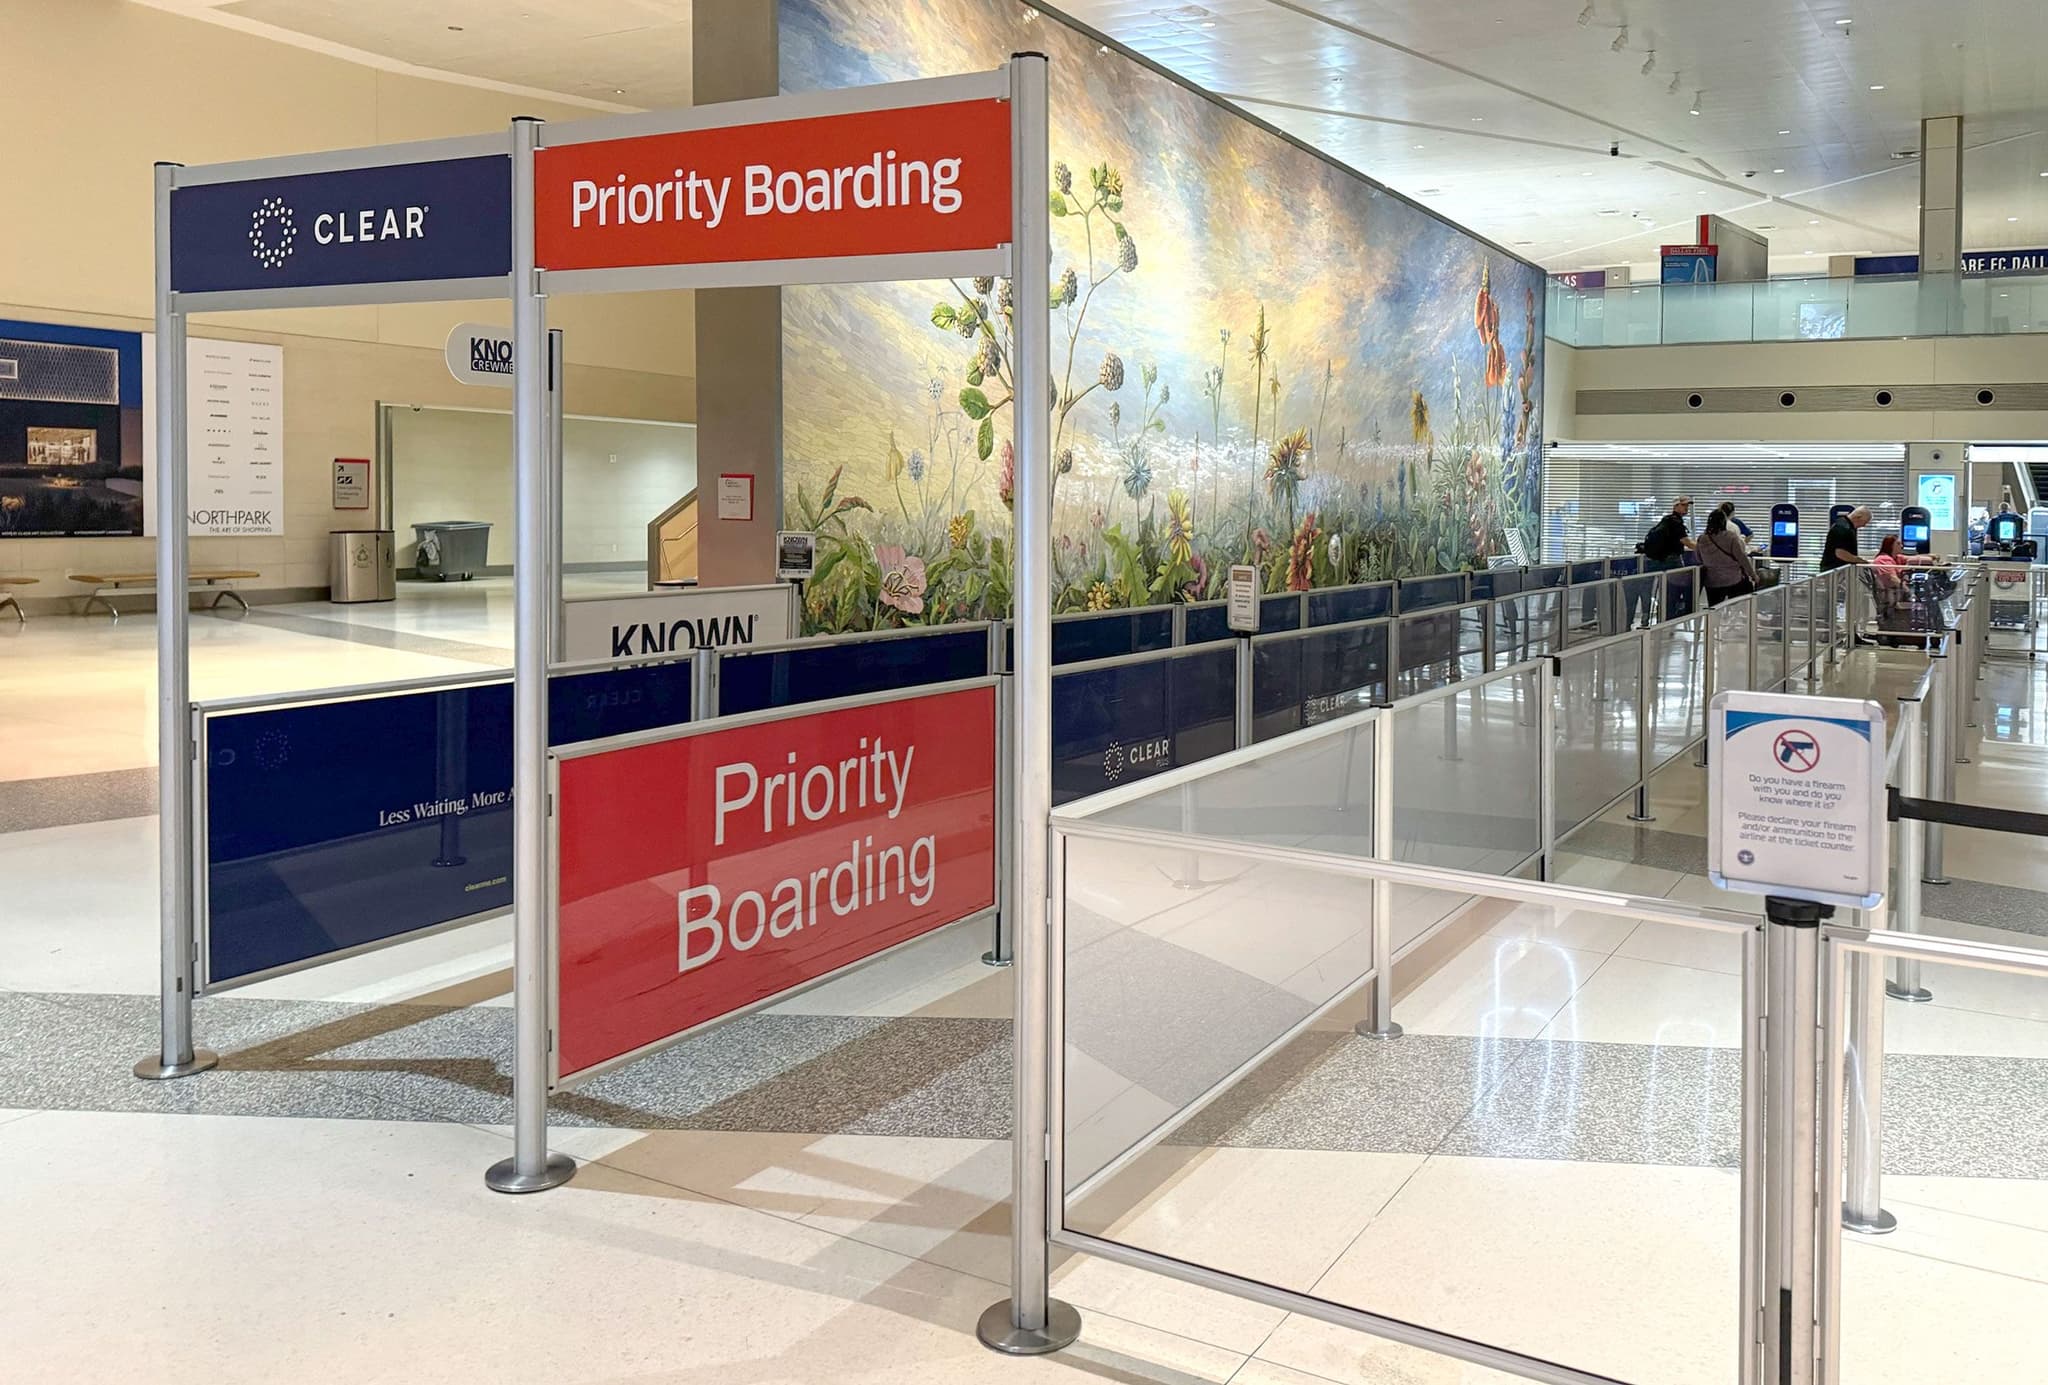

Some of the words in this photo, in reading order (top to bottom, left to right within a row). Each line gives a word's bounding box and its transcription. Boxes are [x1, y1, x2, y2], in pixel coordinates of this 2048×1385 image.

[572, 169, 731, 229] Priority
[745, 149, 963, 216] Boarding
[314, 206, 425, 245] CLEAR
[471, 337, 514, 362] KNO
[612, 614, 754, 658] KNOWN
[1321, 695, 1345, 713] CLEAR
[1130, 740, 1169, 764] CLEAR
[714, 736, 915, 846] Priority
[1749, 774, 1761, 783] Do
[1763, 777, 1780, 786] you
[1782, 778, 1803, 787] have
[1812, 781, 1846, 790] firearm
[1753, 785, 1772, 793] with
[1774, 787, 1790, 796] you
[1793, 789, 1809, 797] and
[1811, 790, 1823, 798] do
[1825, 792, 1842, 801] you
[380, 809, 411, 827] Less
[414, 798, 469, 820] Waiting,
[472, 791, 505, 809] More
[1759, 795, 1783, 804] know
[1785, 798, 1813, 808] where
[1823, 801, 1835, 809] is?
[1738, 812, 1766, 822] Please
[1767, 815, 1799, 825] declare
[1801, 819, 1821, 828] your
[1823, 821, 1856, 832] firearm
[1742, 822, 1771, 832] and/or
[1772, 826, 1825, 838] ammunition
[1827, 832, 1836, 840] to
[1838, 832, 1853, 842] the
[1739, 832, 1766, 843] airline
[1768, 835, 1777, 843] at
[1778, 835, 1793, 845] the
[1795, 839, 1819, 848] ticket
[678, 834, 936, 974] Boarding
